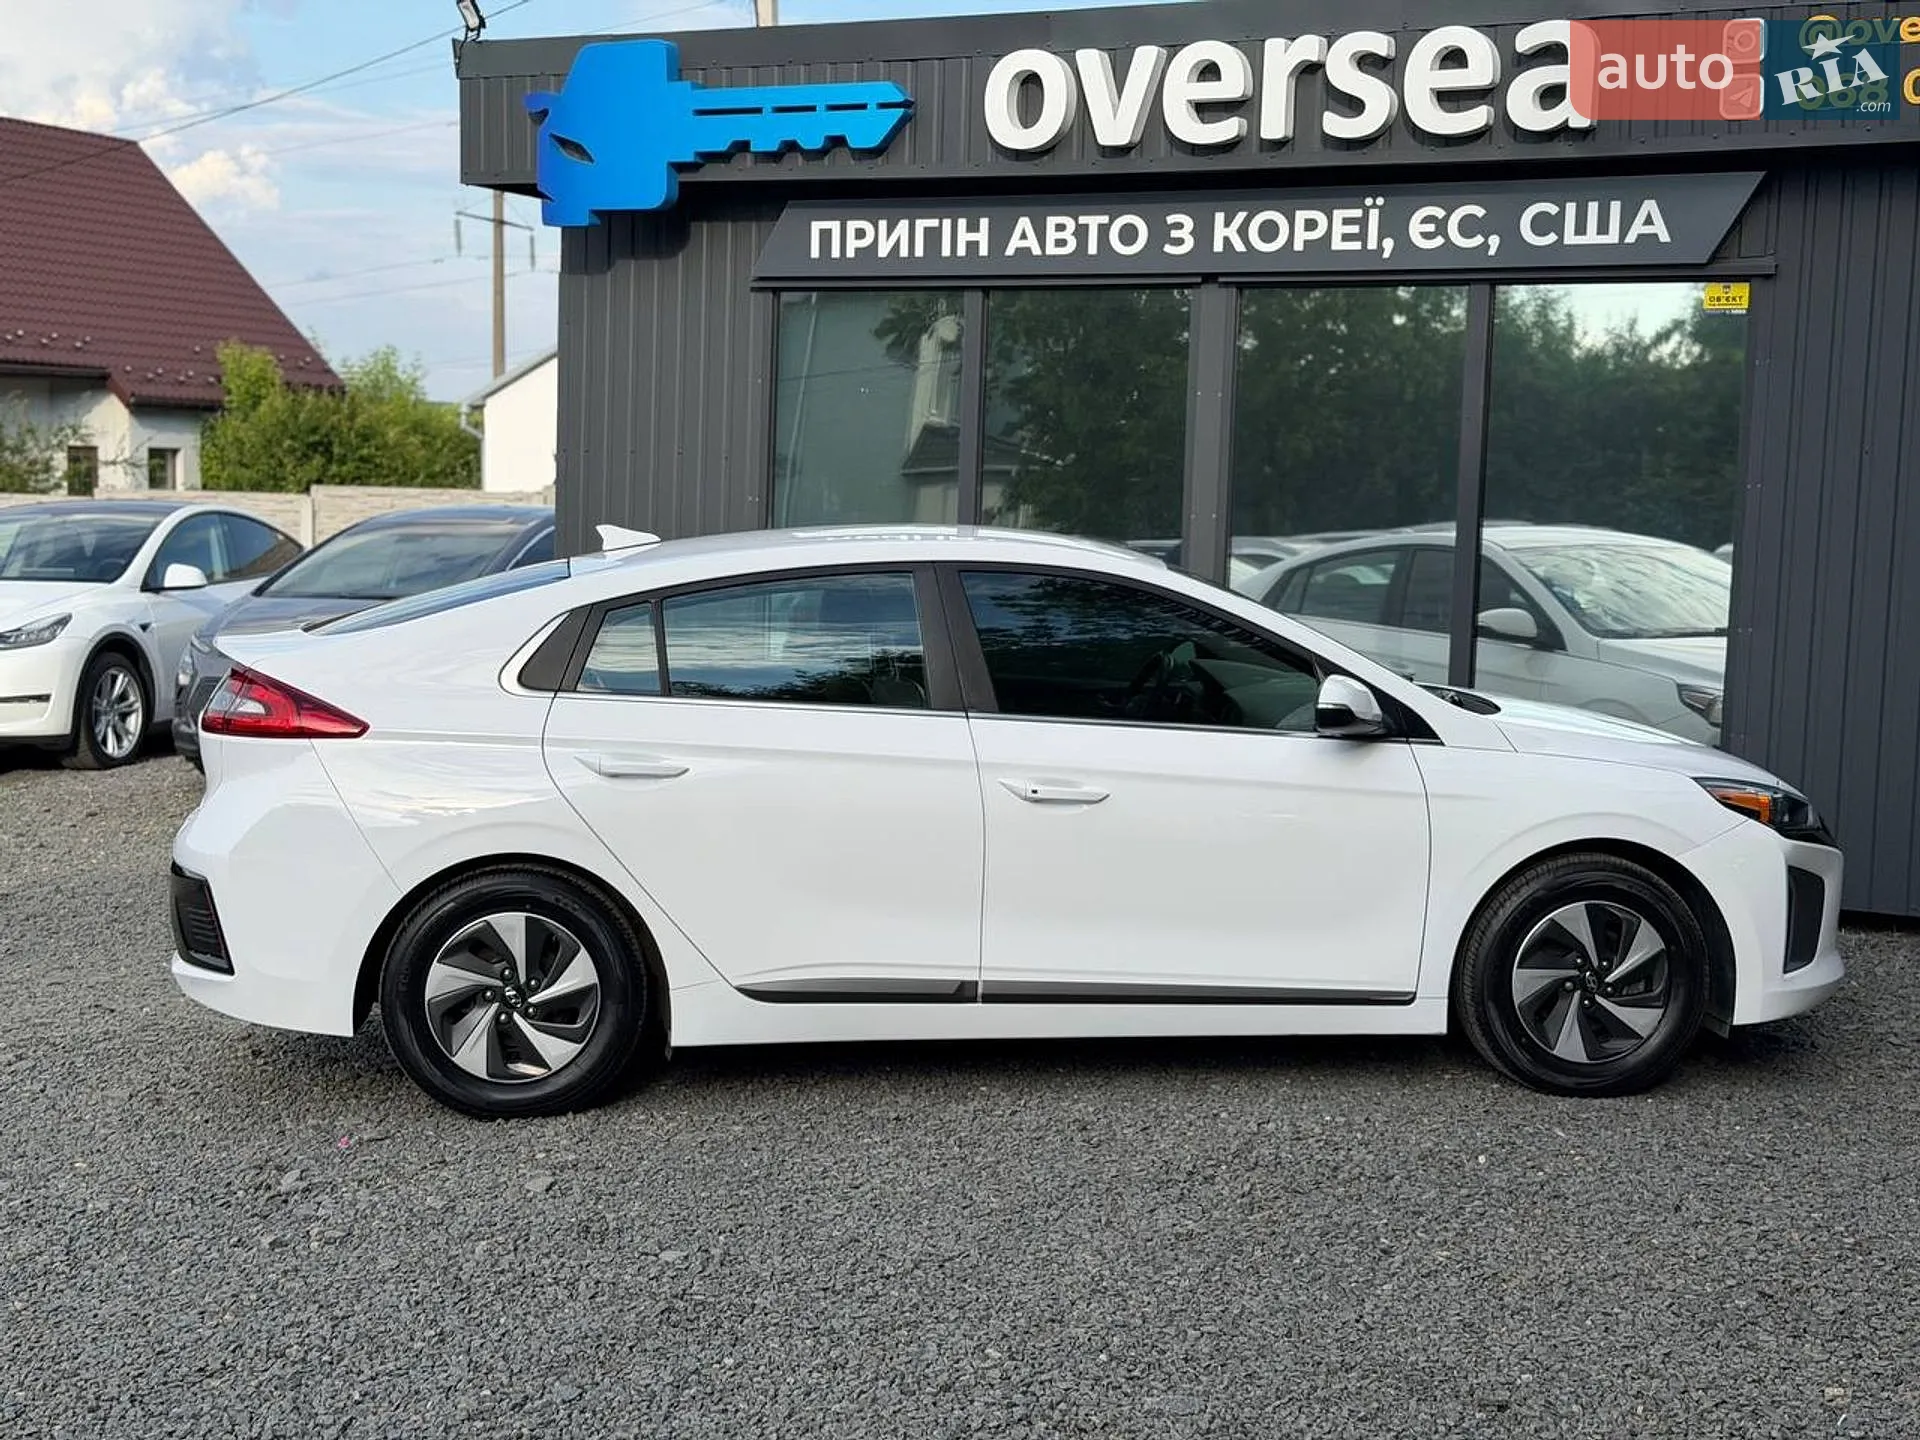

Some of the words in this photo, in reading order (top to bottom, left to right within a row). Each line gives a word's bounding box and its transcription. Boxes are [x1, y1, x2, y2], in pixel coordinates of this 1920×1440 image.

[984, 20, 1598, 151] oversea
[809, 216, 990, 259] ПРИГІН
[1004, 213, 1150, 257] АВТО
[1163, 213, 1195, 255] З
[1213, 196, 1395, 259] КОРЕЇ,
[1408, 204, 1501, 256] ЄС,
[1519, 199, 1672, 246] США
